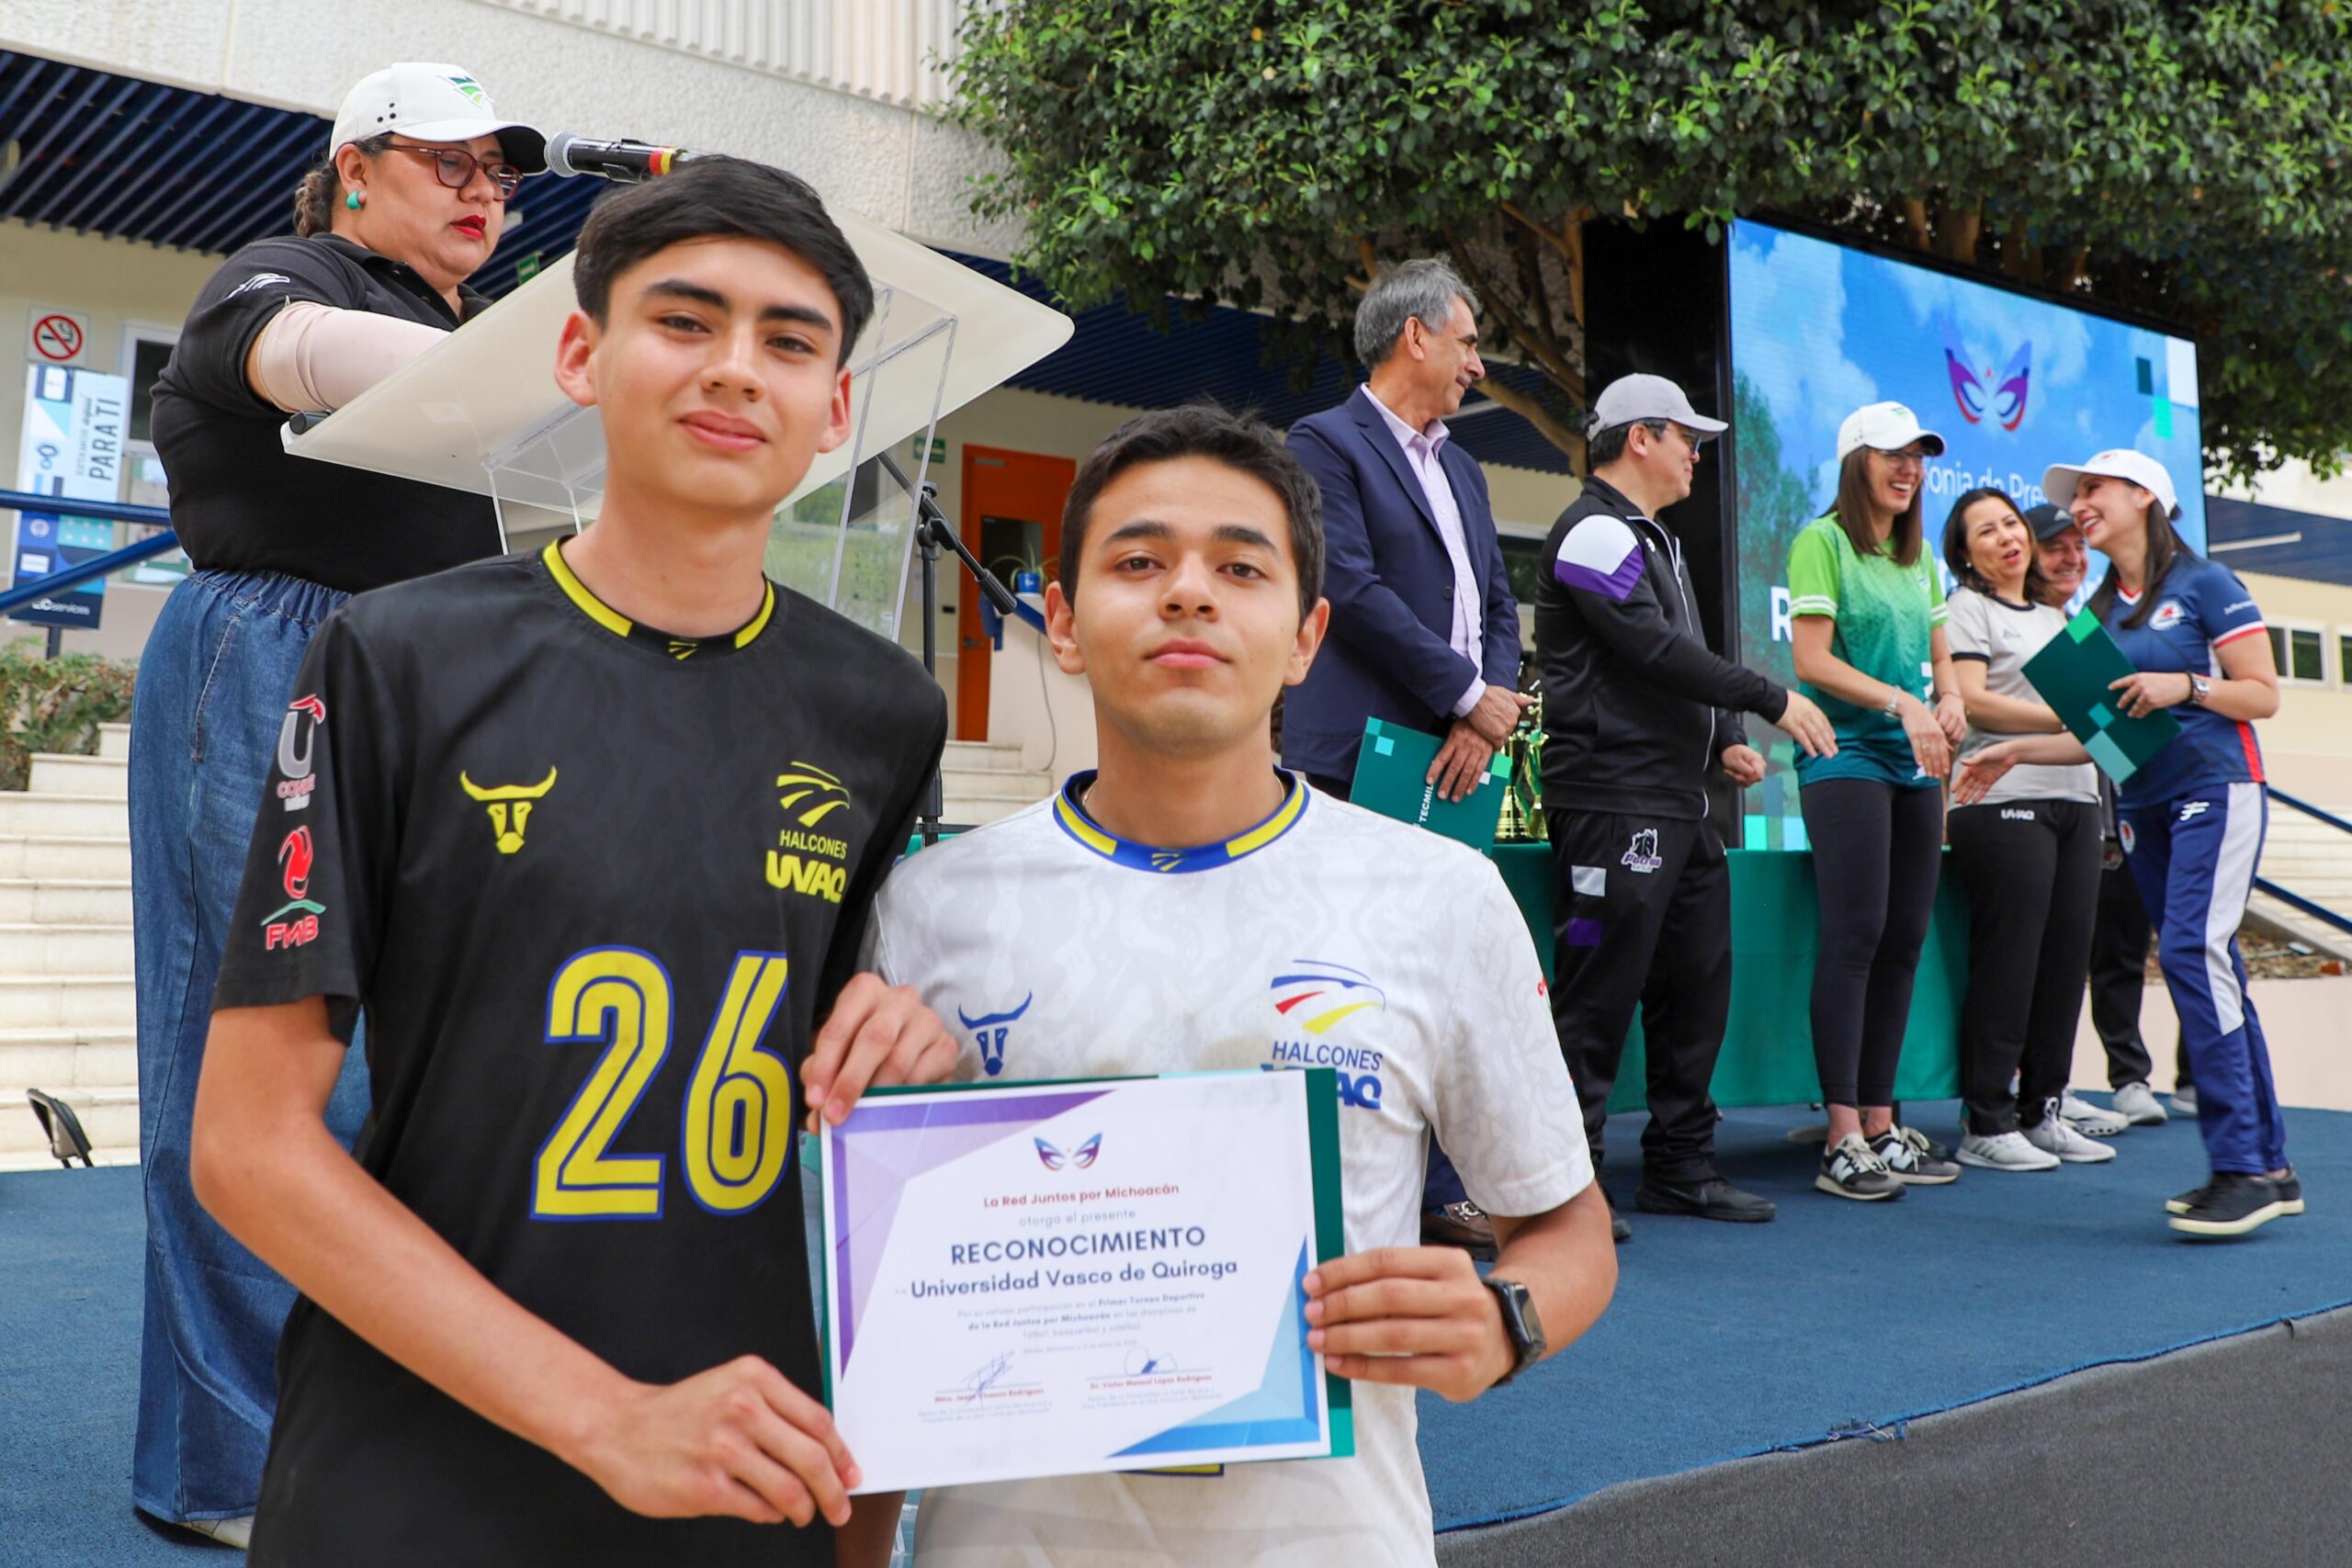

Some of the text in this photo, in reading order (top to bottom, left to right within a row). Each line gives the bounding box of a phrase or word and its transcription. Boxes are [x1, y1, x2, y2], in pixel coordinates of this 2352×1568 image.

[89, 398, 121, 481] PARA TI
[1924, 461, 1973, 496] onia
[2009, 472, 2049, 508] Pre
[1769, 585, 1792, 642] R
[778, 829, 848, 861] HALCONES
[764, 849, 847, 904] UVAQ
[265, 915, 320, 952] FMB
[1272, 1040, 1384, 1072] HALCONES
[529, 944, 796, 1220] 26
[983, 1183, 1180, 1208] La Red Juntos por Michoacán
[1019, 1209, 1136, 1228] otorga el presente
[950, 1224, 1206, 1266] RECONOCIMIENTO
[910, 1270, 1040, 1300] Universidad
[1046, 1269, 1113, 1288] Vasco
[1119, 1262, 1146, 1281] de
[1151, 1259, 1238, 1280] Quiroga
[1098, 1297, 1127, 1307] Primer
[1162, 1291, 1205, 1303] Deportivo
[993, 1319, 1010, 1328] Red
[1012, 1316, 1042, 1327] Juntos
[1061, 1312, 1111, 1323] Michoacán
